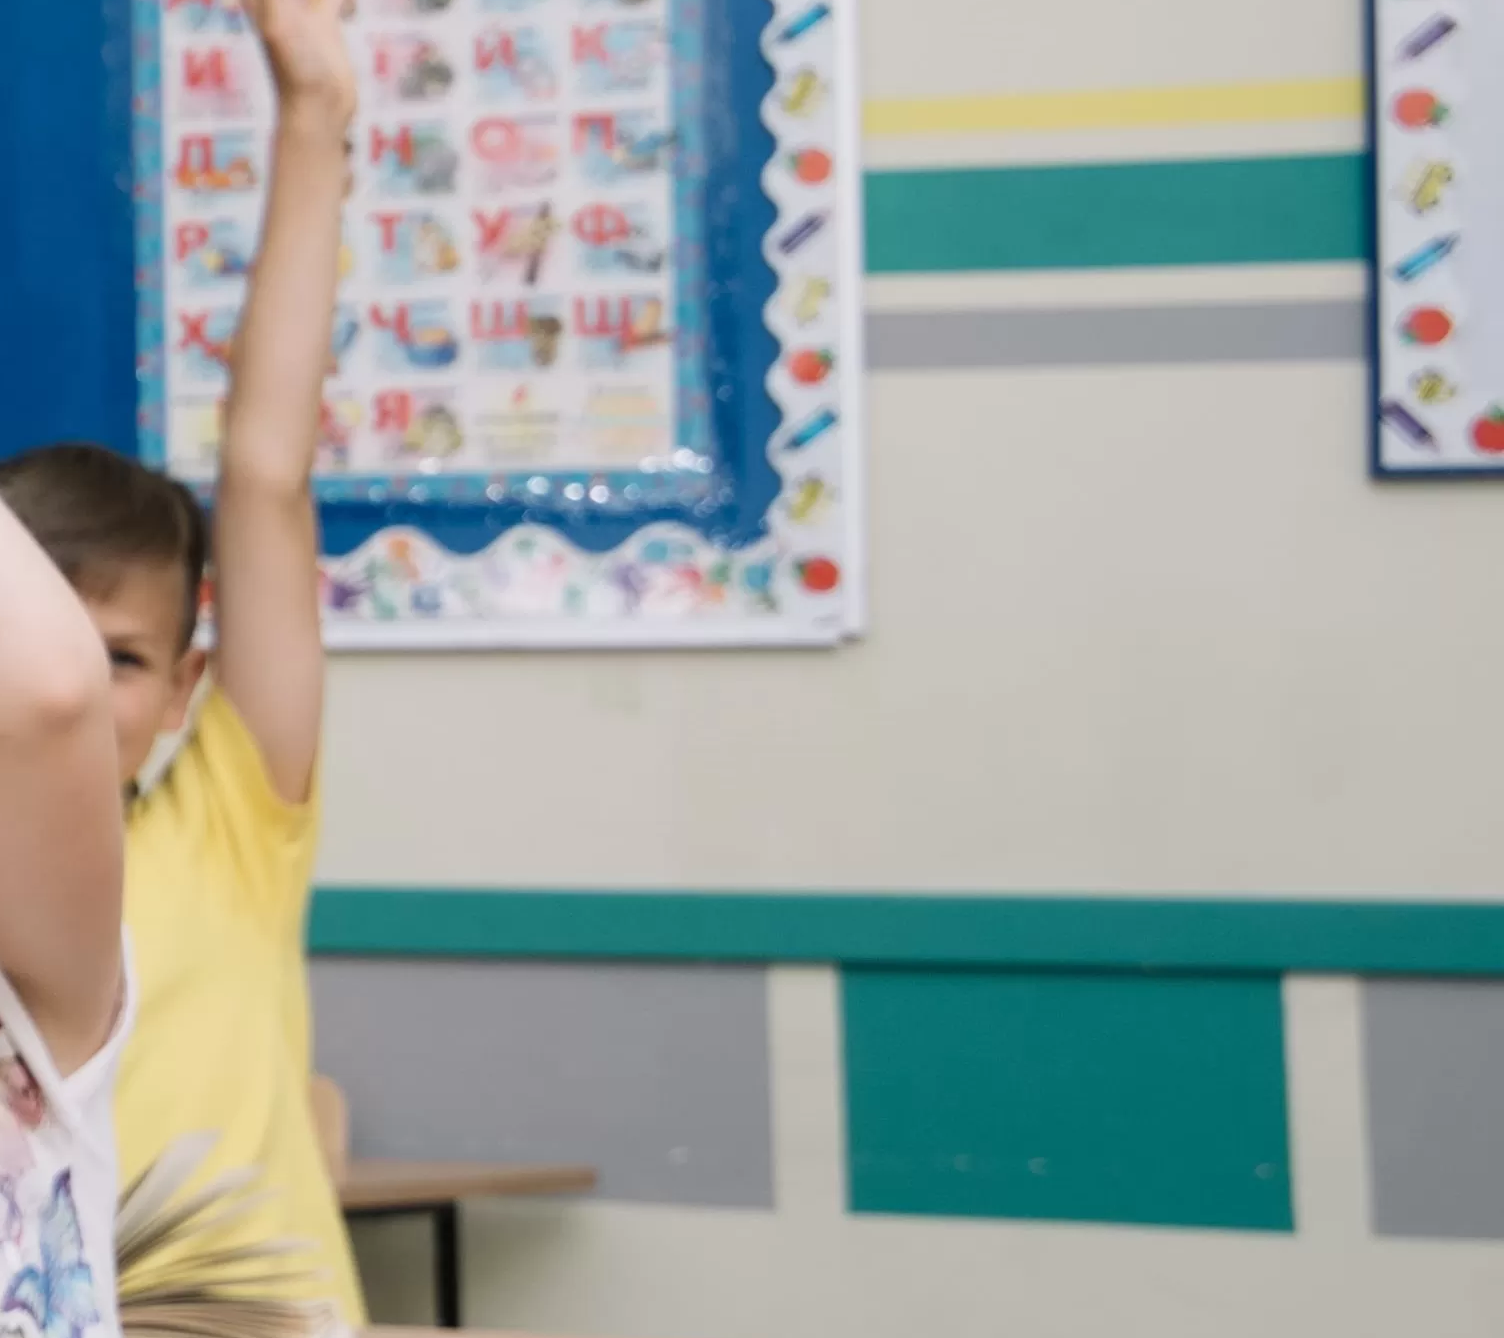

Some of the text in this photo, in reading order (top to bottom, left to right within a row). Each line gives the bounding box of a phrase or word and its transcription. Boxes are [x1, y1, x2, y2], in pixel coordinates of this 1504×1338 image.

[571, 21, 611, 64] К
[370, 125, 414, 165] Н
[572, 112, 615, 152] П
[175, 219, 210, 260] Р
[374, 210, 406, 252] Т
[472, 208, 512, 253] У
[573, 201, 630, 246] Ф
[471, 299, 529, 339] Ш
[375, 390, 413, 431] Я
